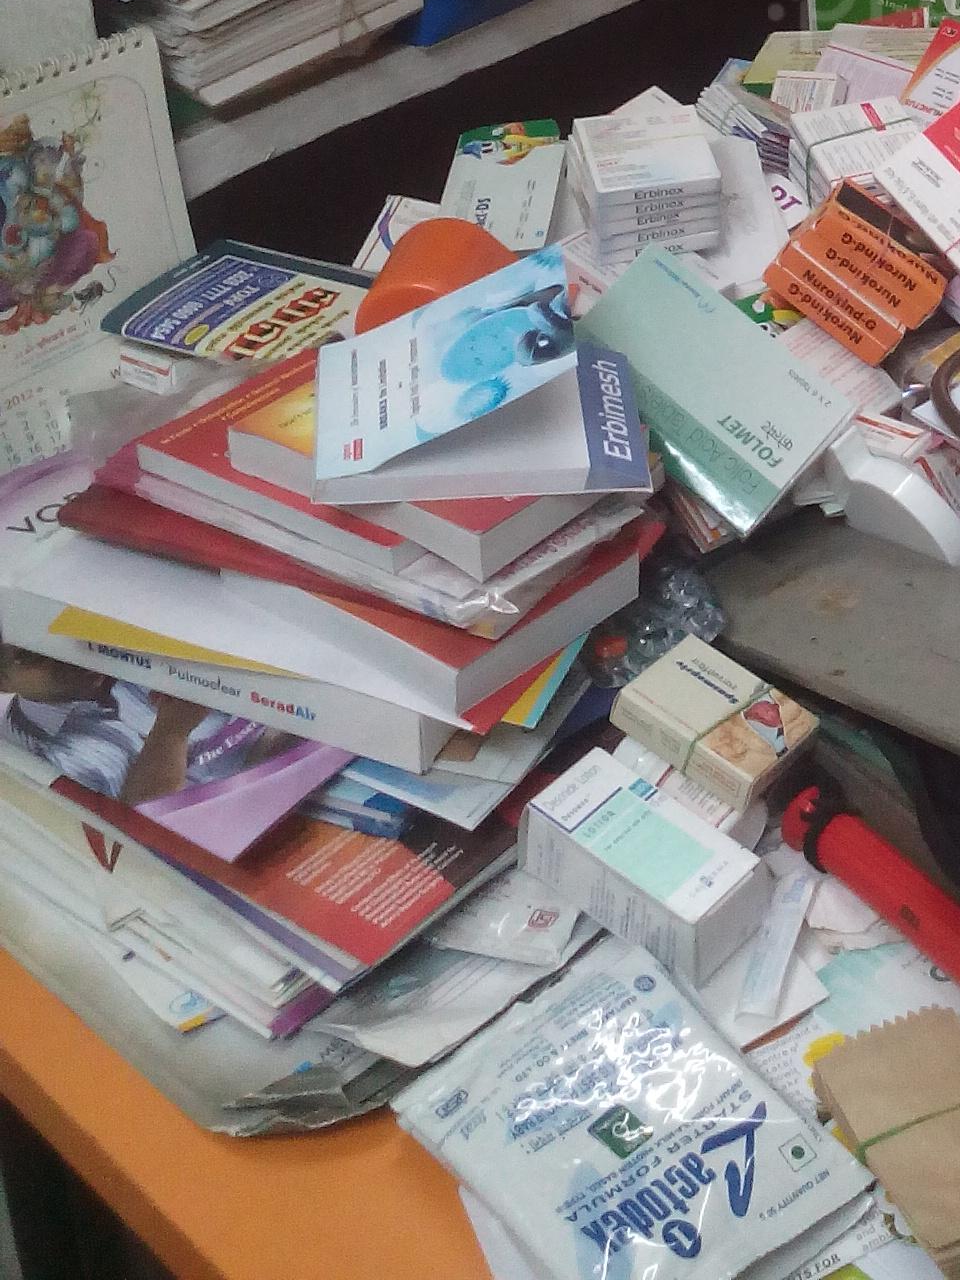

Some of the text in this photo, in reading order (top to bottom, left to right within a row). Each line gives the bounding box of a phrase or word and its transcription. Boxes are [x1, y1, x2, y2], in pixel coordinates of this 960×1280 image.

[633, 183, 686, 202] Erbinox
[634, 198, 687, 216] Erbinox
[636, 211, 682, 228] Erbinox
[636, 224, 687, 244] Erbinox
[823, 245, 902, 309] Nurokind-G
[840, 229, 918, 294] Nurokind-G
[786, 280, 863, 346] Nurokind-G
[799, 269, 879, 331] Nurokind-G
[603, 358, 633, 462] Erbimesh
[687, 427, 726, 463] Acid
[716, 413, 783, 469] FOLMET
[718, 453, 762, 494] Folic
[564, 1089, 753, 1223] STARTER FORMULA
[817, 1253, 842, 1276] FOR
